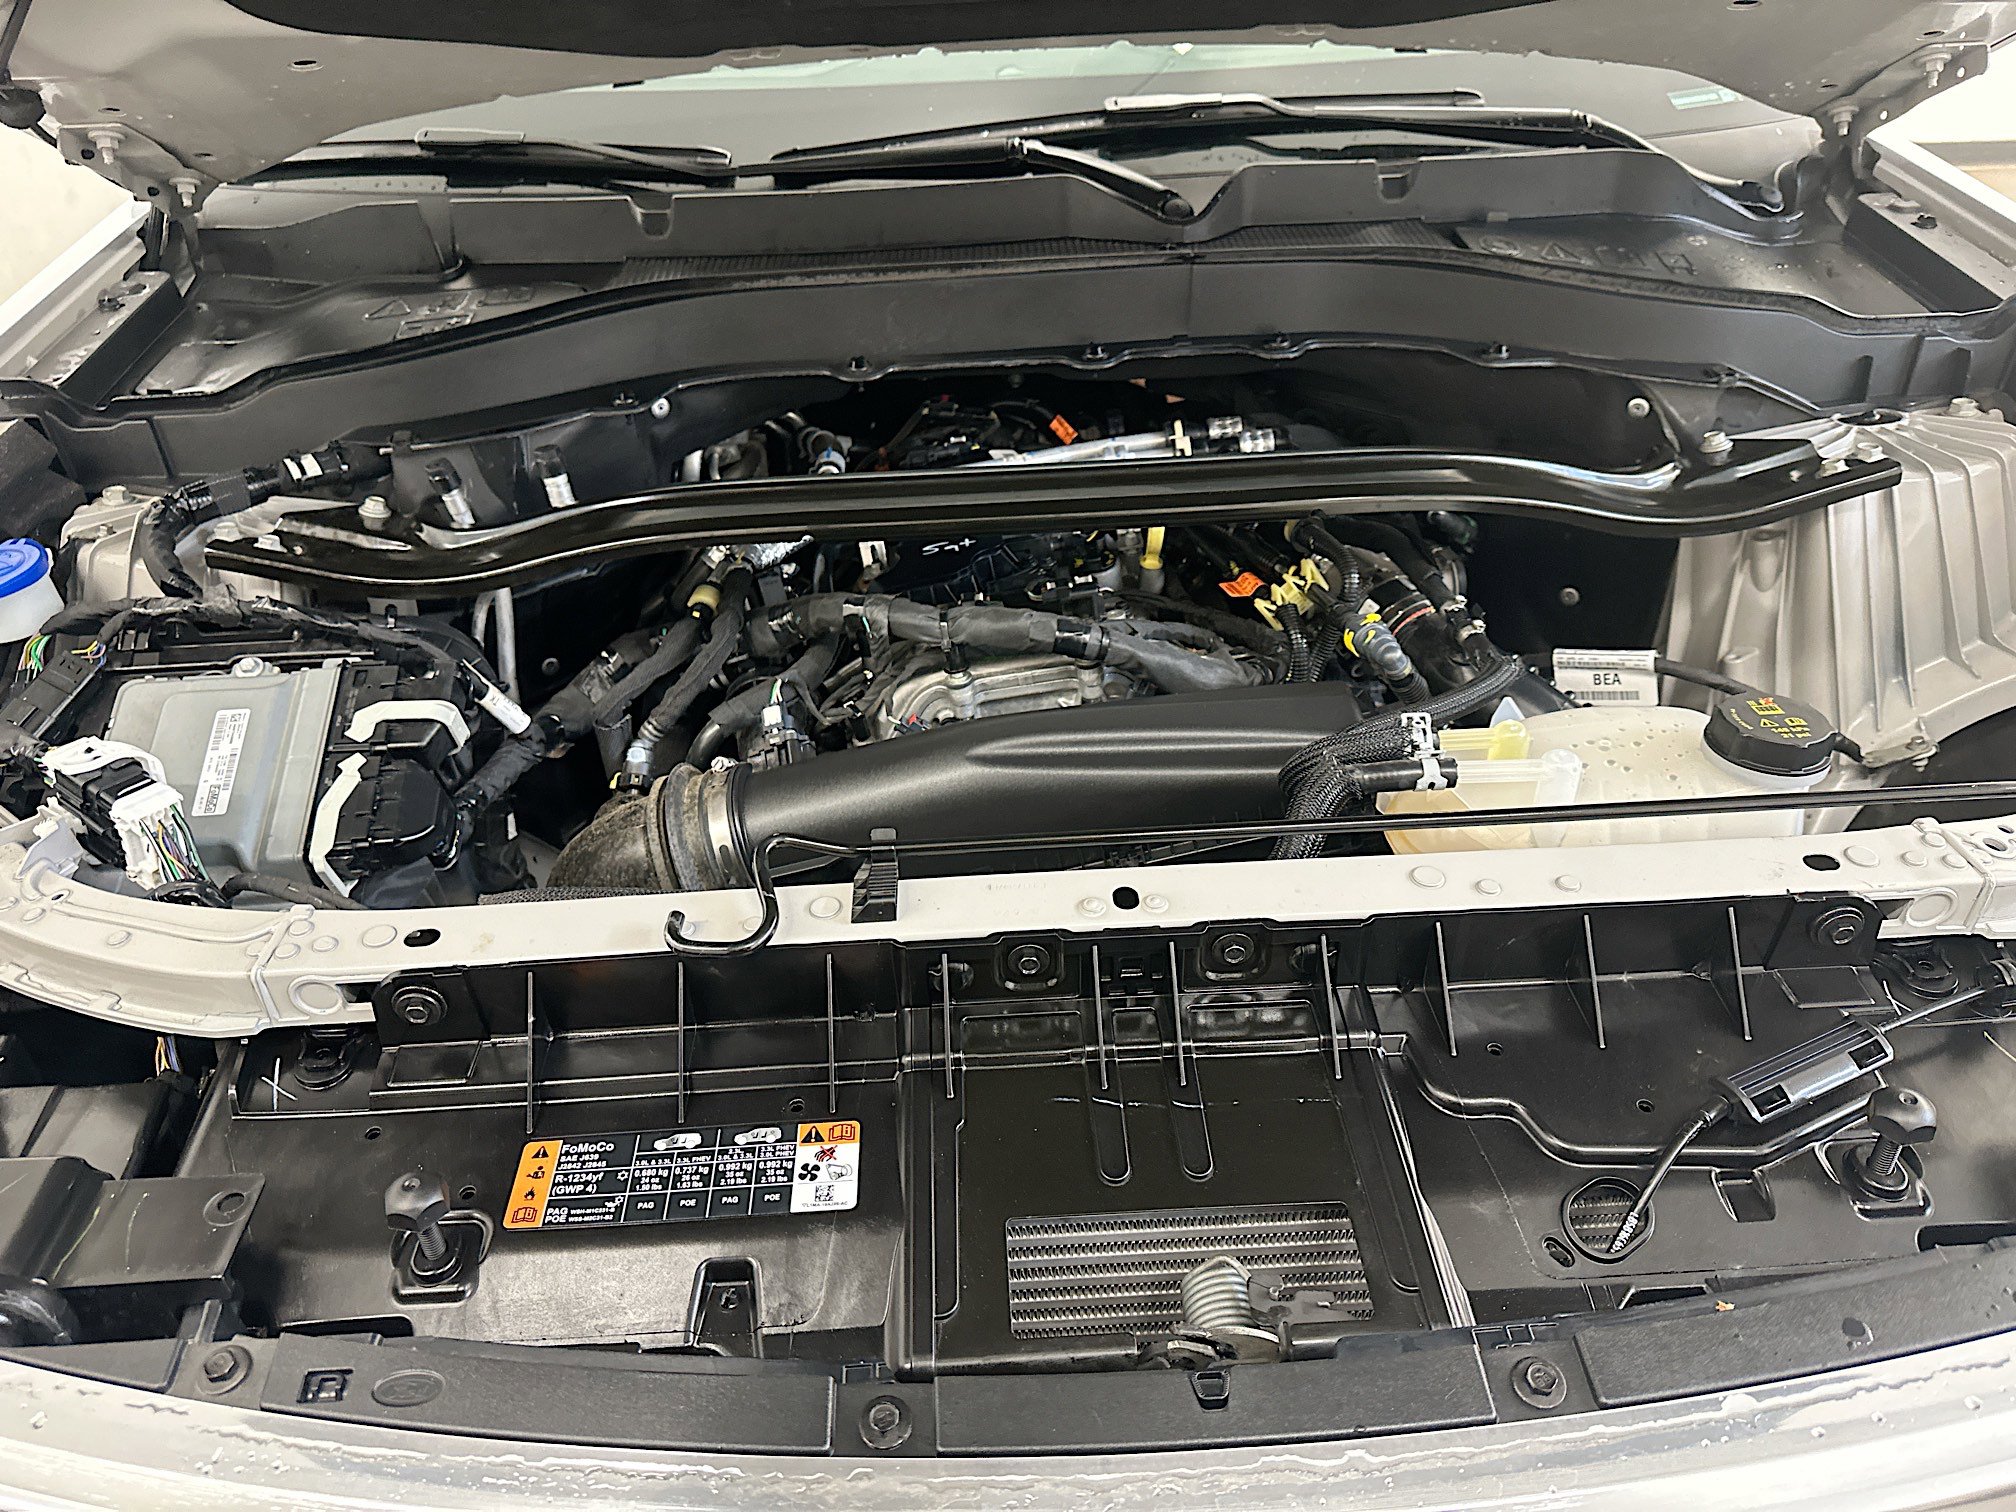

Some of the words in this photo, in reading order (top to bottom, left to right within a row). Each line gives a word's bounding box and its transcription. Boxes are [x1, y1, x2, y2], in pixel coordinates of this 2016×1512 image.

[1593, 673, 1622, 685] BEA
[561, 1142, 615, 1154] FoMoCo
[579, 1153, 600, 1161] J639
[719, 1162, 741, 1171] 0.992
[742, 1161, 753, 1171] kg
[759, 1160, 781, 1169] 0.992
[782, 1160, 793, 1169] kg
[634, 1169, 657, 1178] 0.680
[657, 1168, 669, 1177] kg
[675, 1166, 697, 1174] 0.737
[698, 1165, 710, 1174] kg
[554, 1172, 604, 1184] R-1234yf
[736, 1177, 747, 1185] lbs
[551, 1184, 584, 1196] (GWP
[585, 1184, 597, 1194] 4)
[721, 1196, 739, 1204] PAG
[764, 1193, 781, 1202] POE
[637, 1202, 655, 1210] PAG
[680, 1199, 697, 1207] POE
[546, 1207, 569, 1216] PAG
[544, 1215, 567, 1223] POE
